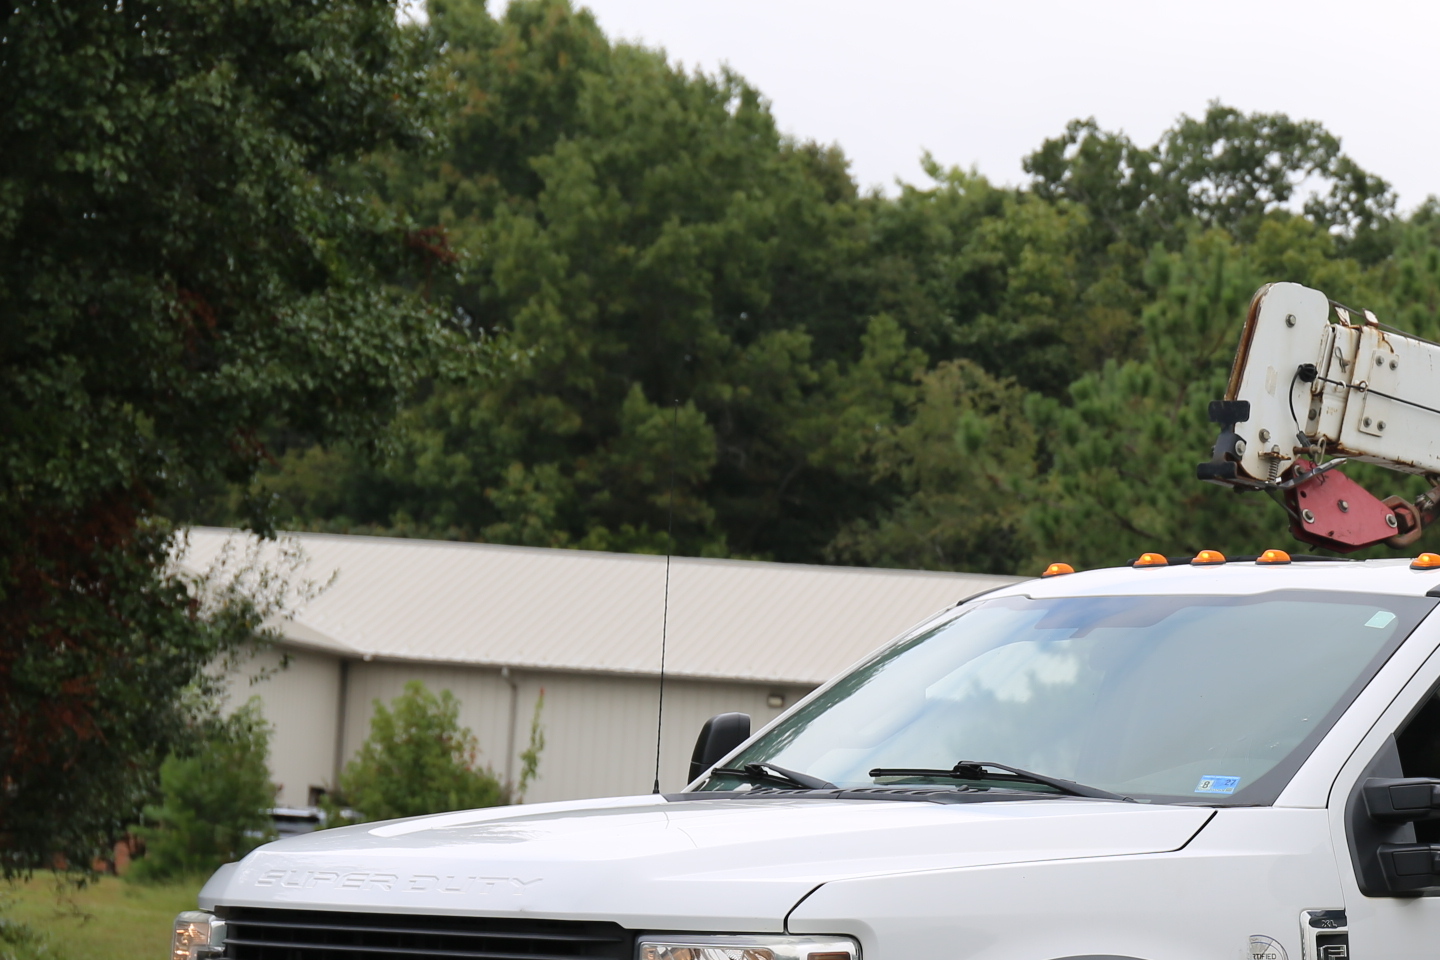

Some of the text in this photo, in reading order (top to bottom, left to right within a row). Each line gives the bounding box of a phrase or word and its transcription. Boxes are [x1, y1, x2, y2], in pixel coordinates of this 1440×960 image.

[255, 868, 545, 896] SUPER DUTY
[1322, 919, 1338, 928] XL
